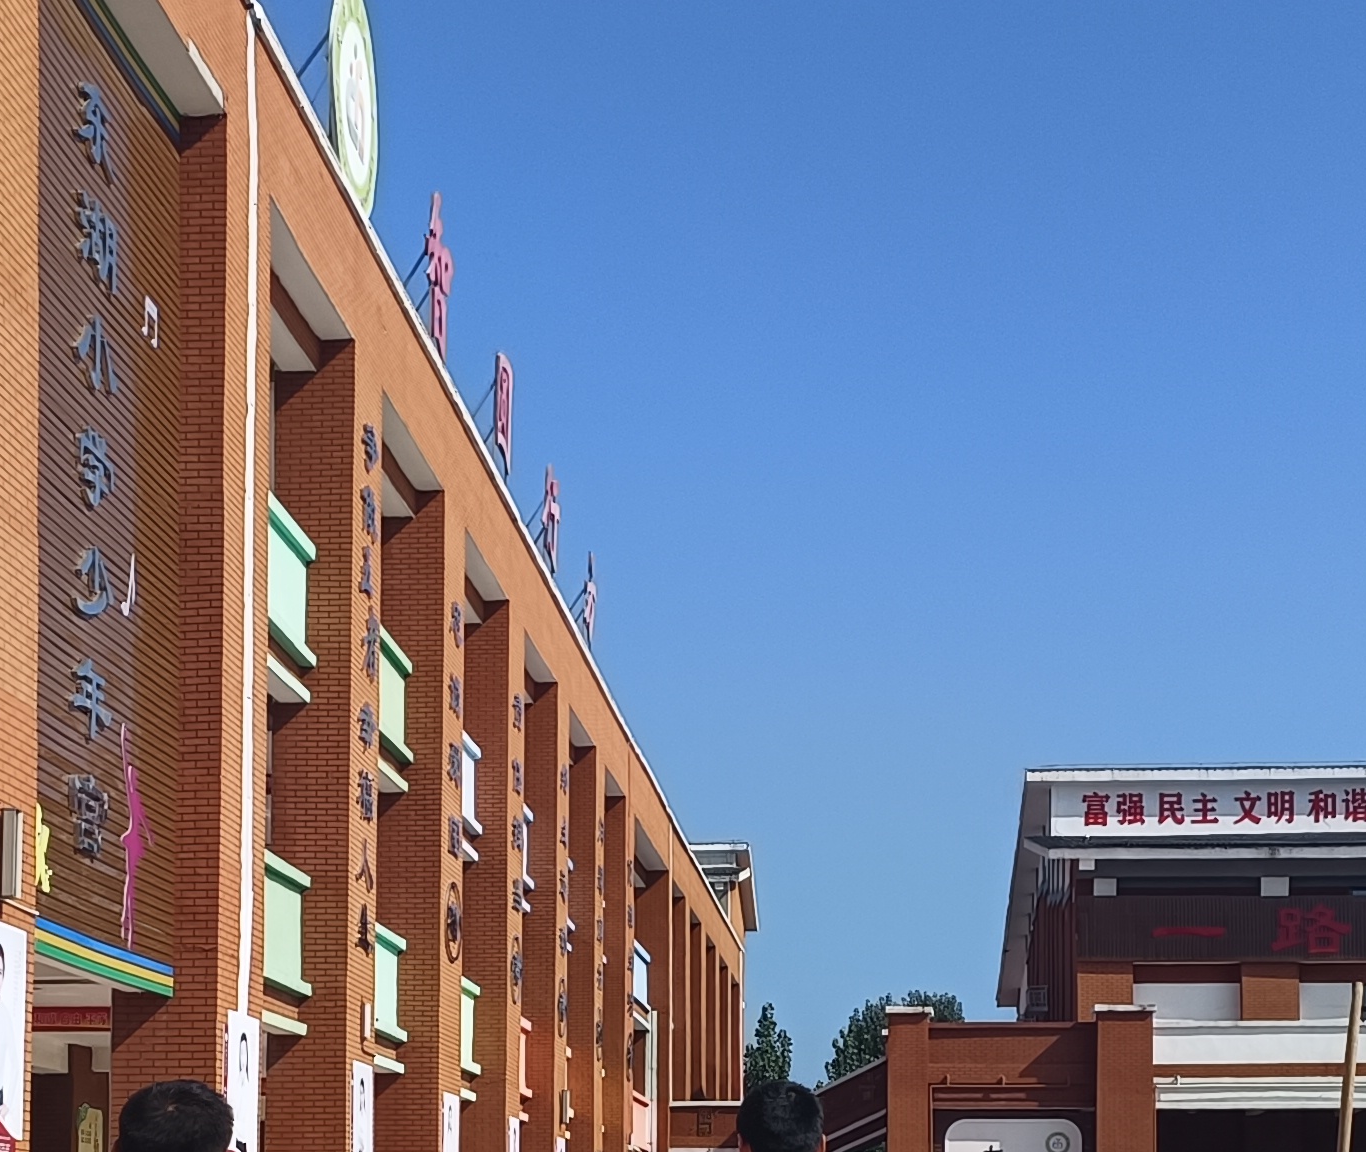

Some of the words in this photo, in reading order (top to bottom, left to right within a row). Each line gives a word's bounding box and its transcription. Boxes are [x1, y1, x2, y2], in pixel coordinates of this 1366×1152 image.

[1082, 793, 1145, 826] 富强
[1157, 792, 1219, 826] 民主
[1234, 790, 1296, 825] 文明
